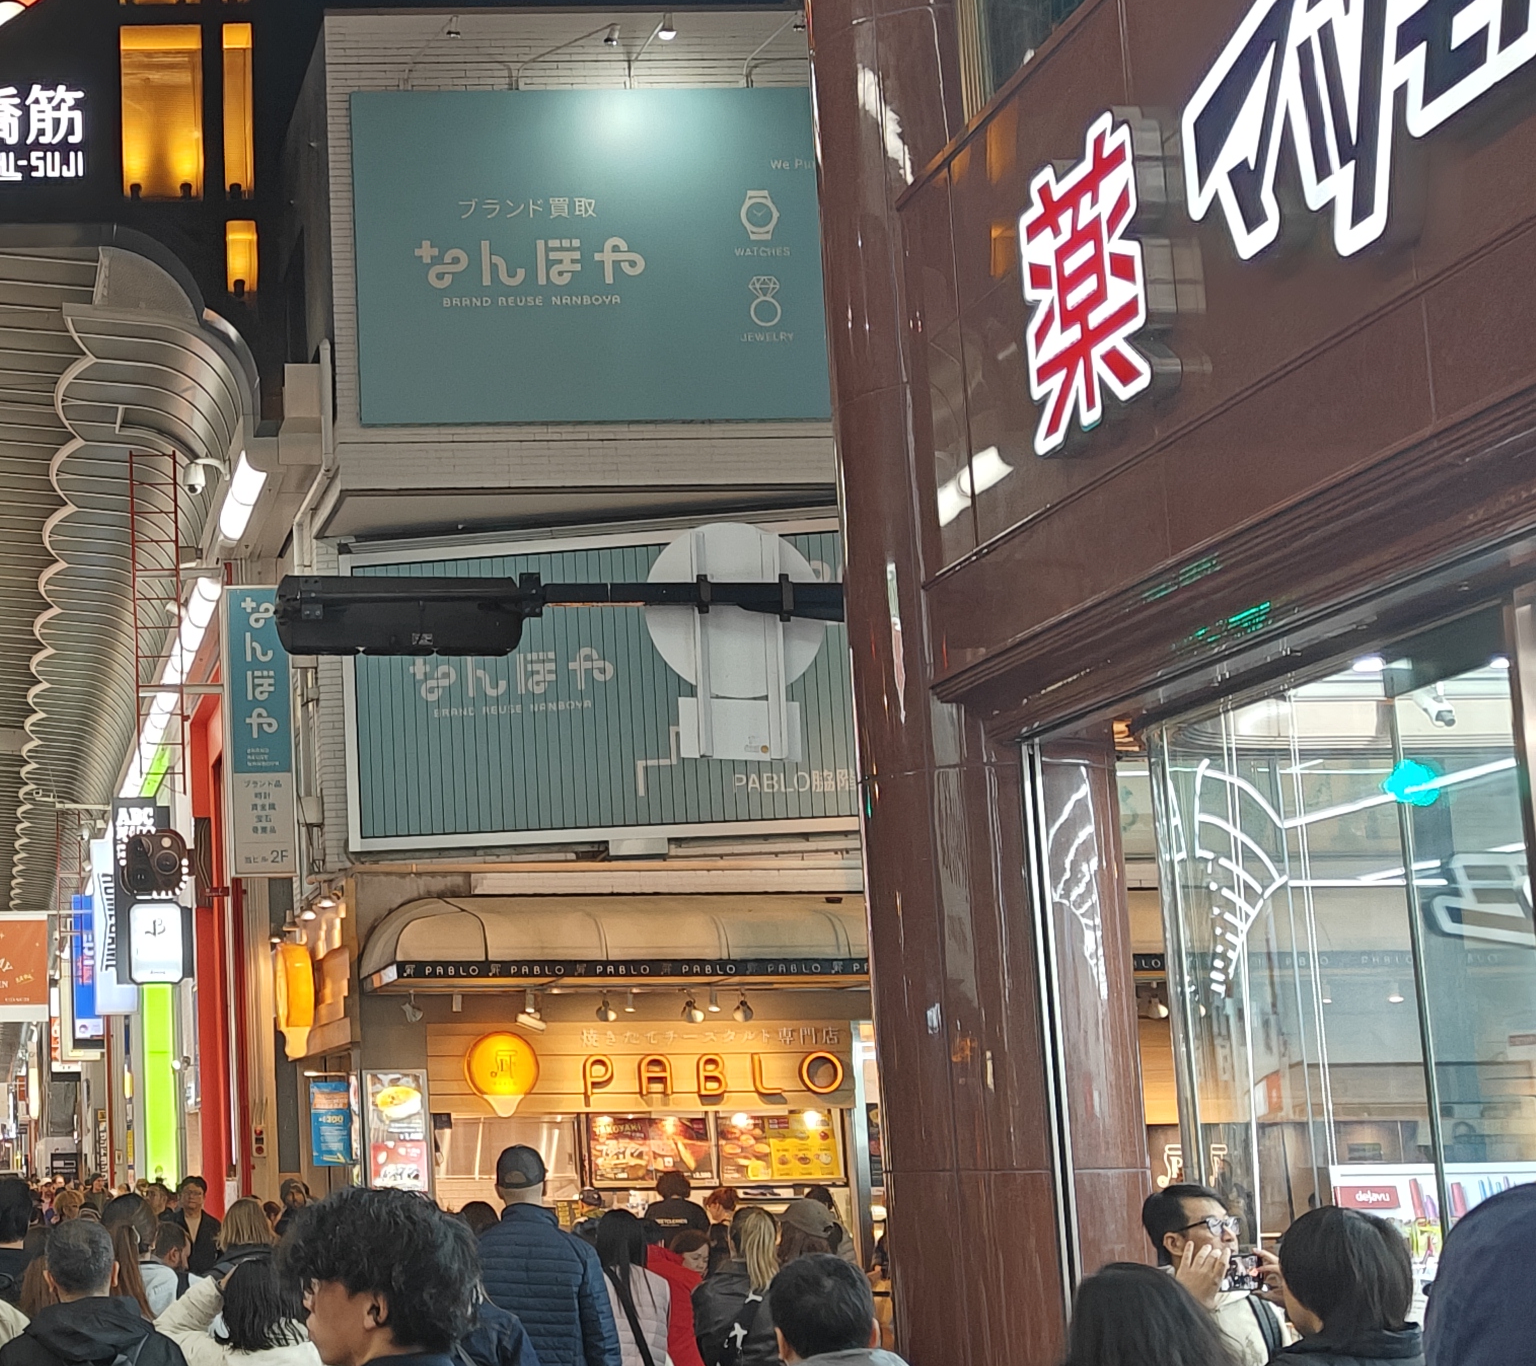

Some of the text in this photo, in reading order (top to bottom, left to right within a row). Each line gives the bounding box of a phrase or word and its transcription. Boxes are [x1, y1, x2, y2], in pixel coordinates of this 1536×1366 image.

[770, 159, 790, 170] We
[458, 197, 597, 219] ブランド買取
[734, 247, 791, 257] WATCHES
[414, 237, 645, 289] なんぼや
[1020, 112, 1150, 455] 薬
[442, 294, 621, 308] BRAND REUSE NANBOYA
[740, 332, 794, 342] JEWELRY
[240, 596, 279, 740] なんぼや
[409, 646, 614, 702] なんぼや
[433, 699, 592, 718] BRAND REUSE NANBOYA
[270, 849, 289, 864] 2F
[424, 965, 479, 976] PABLO
[510, 965, 564, 976] PABLO
[596, 964, 650, 976] PABLO
[682, 964, 736, 975] PABLO
[767, 963, 821, 974] PABLO
[583, 1050, 844, 1098] PABLO
